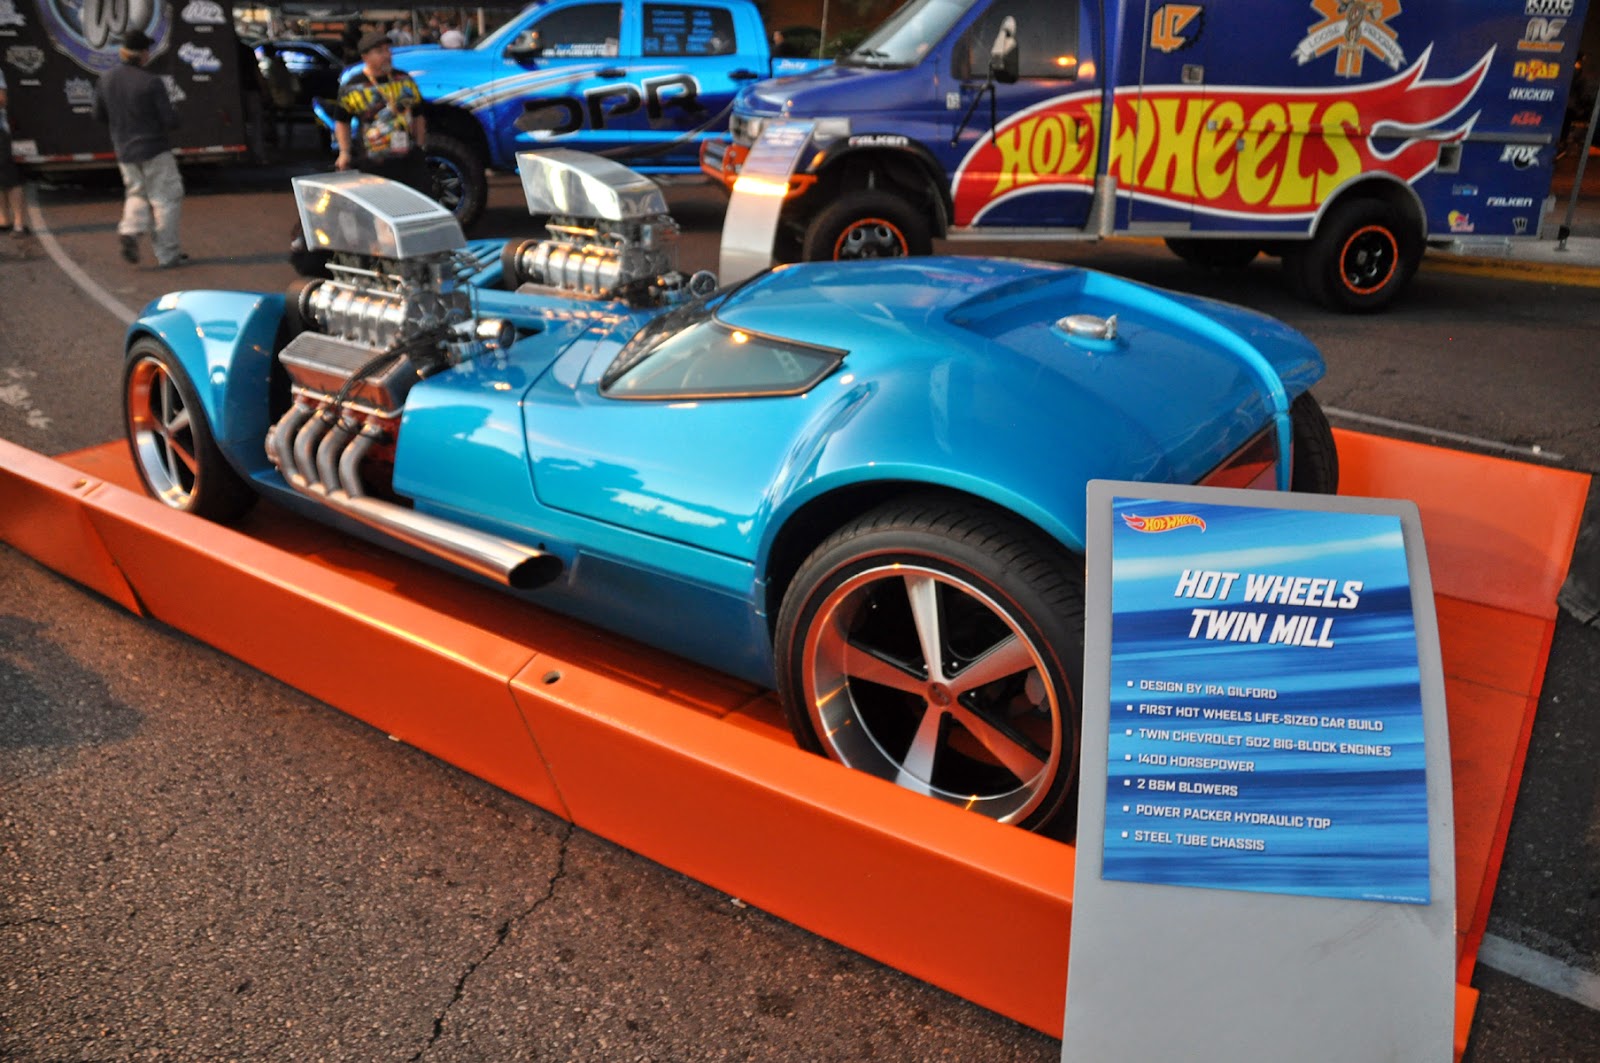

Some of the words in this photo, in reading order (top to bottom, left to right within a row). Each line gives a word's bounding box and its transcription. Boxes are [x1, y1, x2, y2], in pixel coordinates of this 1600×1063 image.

[1516, 87, 1555, 101] KICKER
[848, 135, 909, 146] FALKEN
[1486, 196, 1533, 207] FALKEN
[1174, 569, 1240, 601] HOT
[1244, 573, 1363, 609] WHEELS
[1188, 608, 1268, 643] TWIN
[1268, 613, 1334, 648] MILL
[1140, 680, 1183, 693] DESIGN
[1186, 683, 1202, 694] BY
[1205, 685, 1225, 696] IRA
[1227, 686, 1277, 700] GILFORD
[1139, 704, 1173, 716] FIRST
[1175, 706, 1200, 718] HOT
[1203, 708, 1252, 722] WHEELS
[1255, 712, 1319, 727] LIFE-SIZED
[1321, 716, 1345, 729] CAR
[1348, 719, 1384, 731] BUILD
[1139, 728, 1169, 740] TWIN
[1172, 731, 1242, 746] CHEVROLET
[1246, 736, 1270, 748] 502
[1273, 738, 1337, 753] BIG-BLOCK
[1340, 743, 1391, 757] ENGINES
[1138, 753, 1167, 766] 1400
[1170, 756, 1255, 772] HORSEPOWER
[1137, 778, 1146, 789] 2
[1178, 782, 1238, 797] BLOWERS
[1136, 804, 1180, 818] POWER
[1183, 808, 1232, 822] PACKER
[1234, 812, 1304, 828] HYDRAULIC
[1306, 817, 1331, 829] TOP
[1134, 830, 1172, 844] STEEL
[1175, 833, 1208, 846] TUBE
[1211, 836, 1265, 851] CHASSIS
